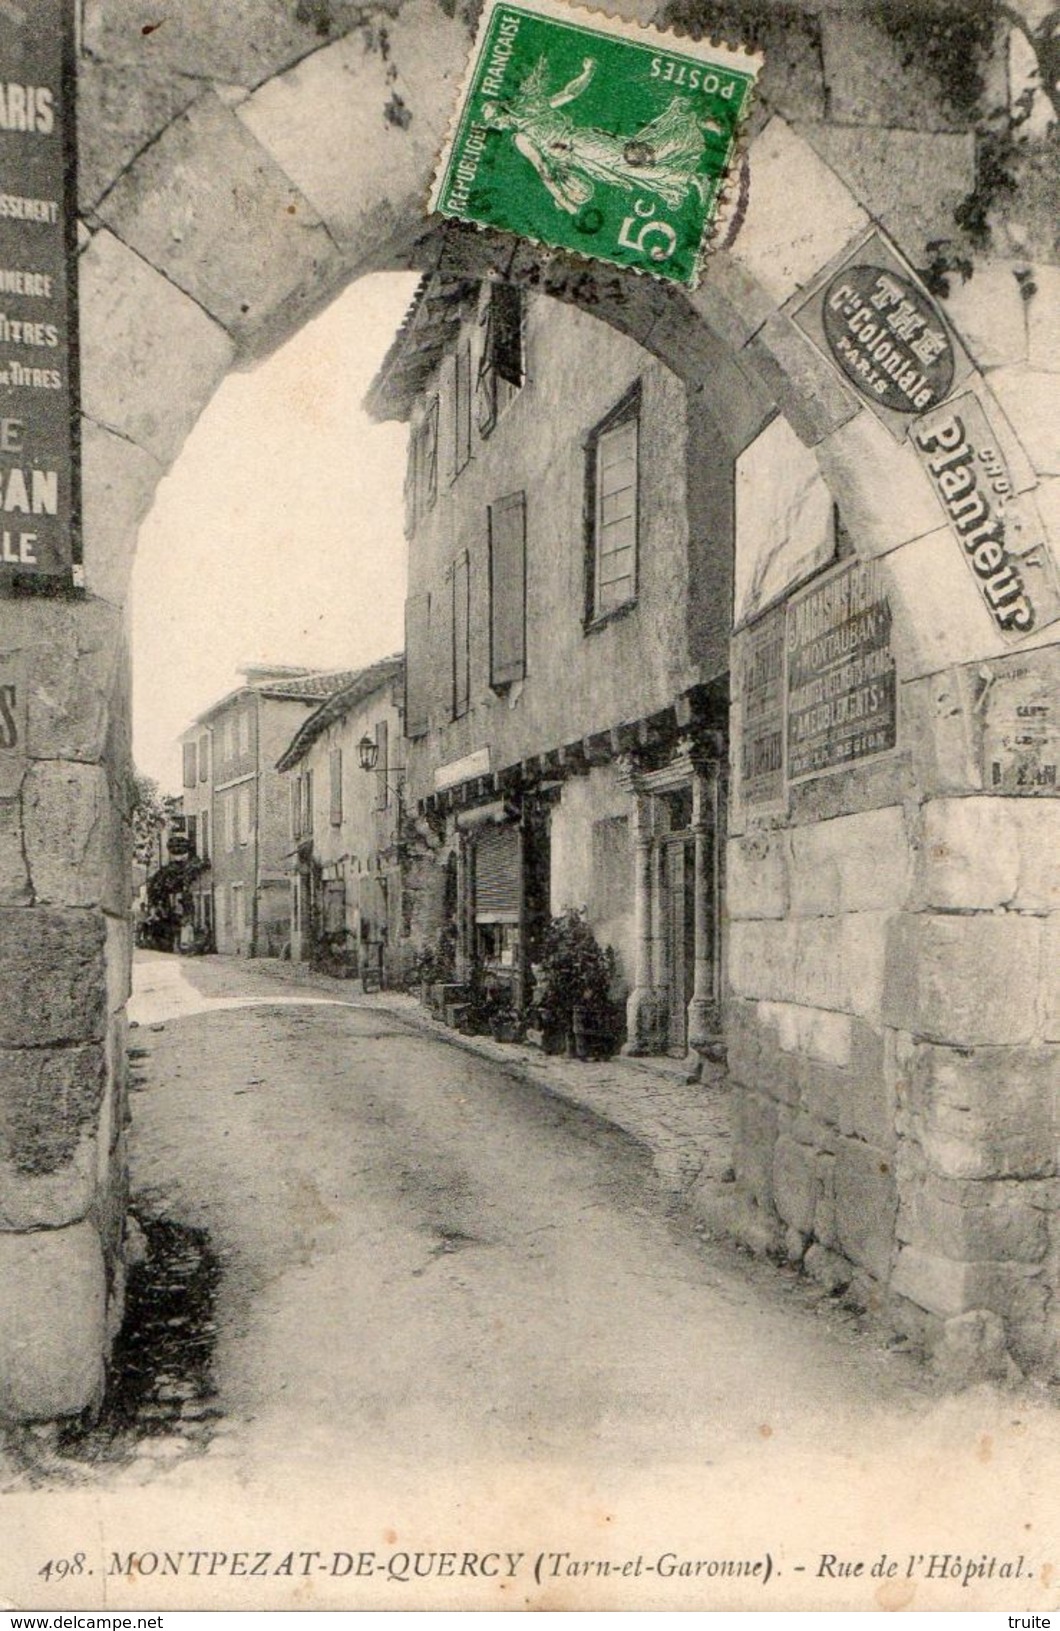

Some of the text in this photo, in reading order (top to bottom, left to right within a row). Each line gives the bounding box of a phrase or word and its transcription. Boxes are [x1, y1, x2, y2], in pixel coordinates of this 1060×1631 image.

[650, 57, 736, 100] POSTES
[9, 360, 62, 390] TITRES
[836, 335, 889, 395] PARIS
[848, 306, 935, 409] Coloniale
[1, 417, 23, 452] E
[0, 468, 58, 515] AN
[915, 414, 1035, 633] Planteur
[0, 530, 37, 564] LE
